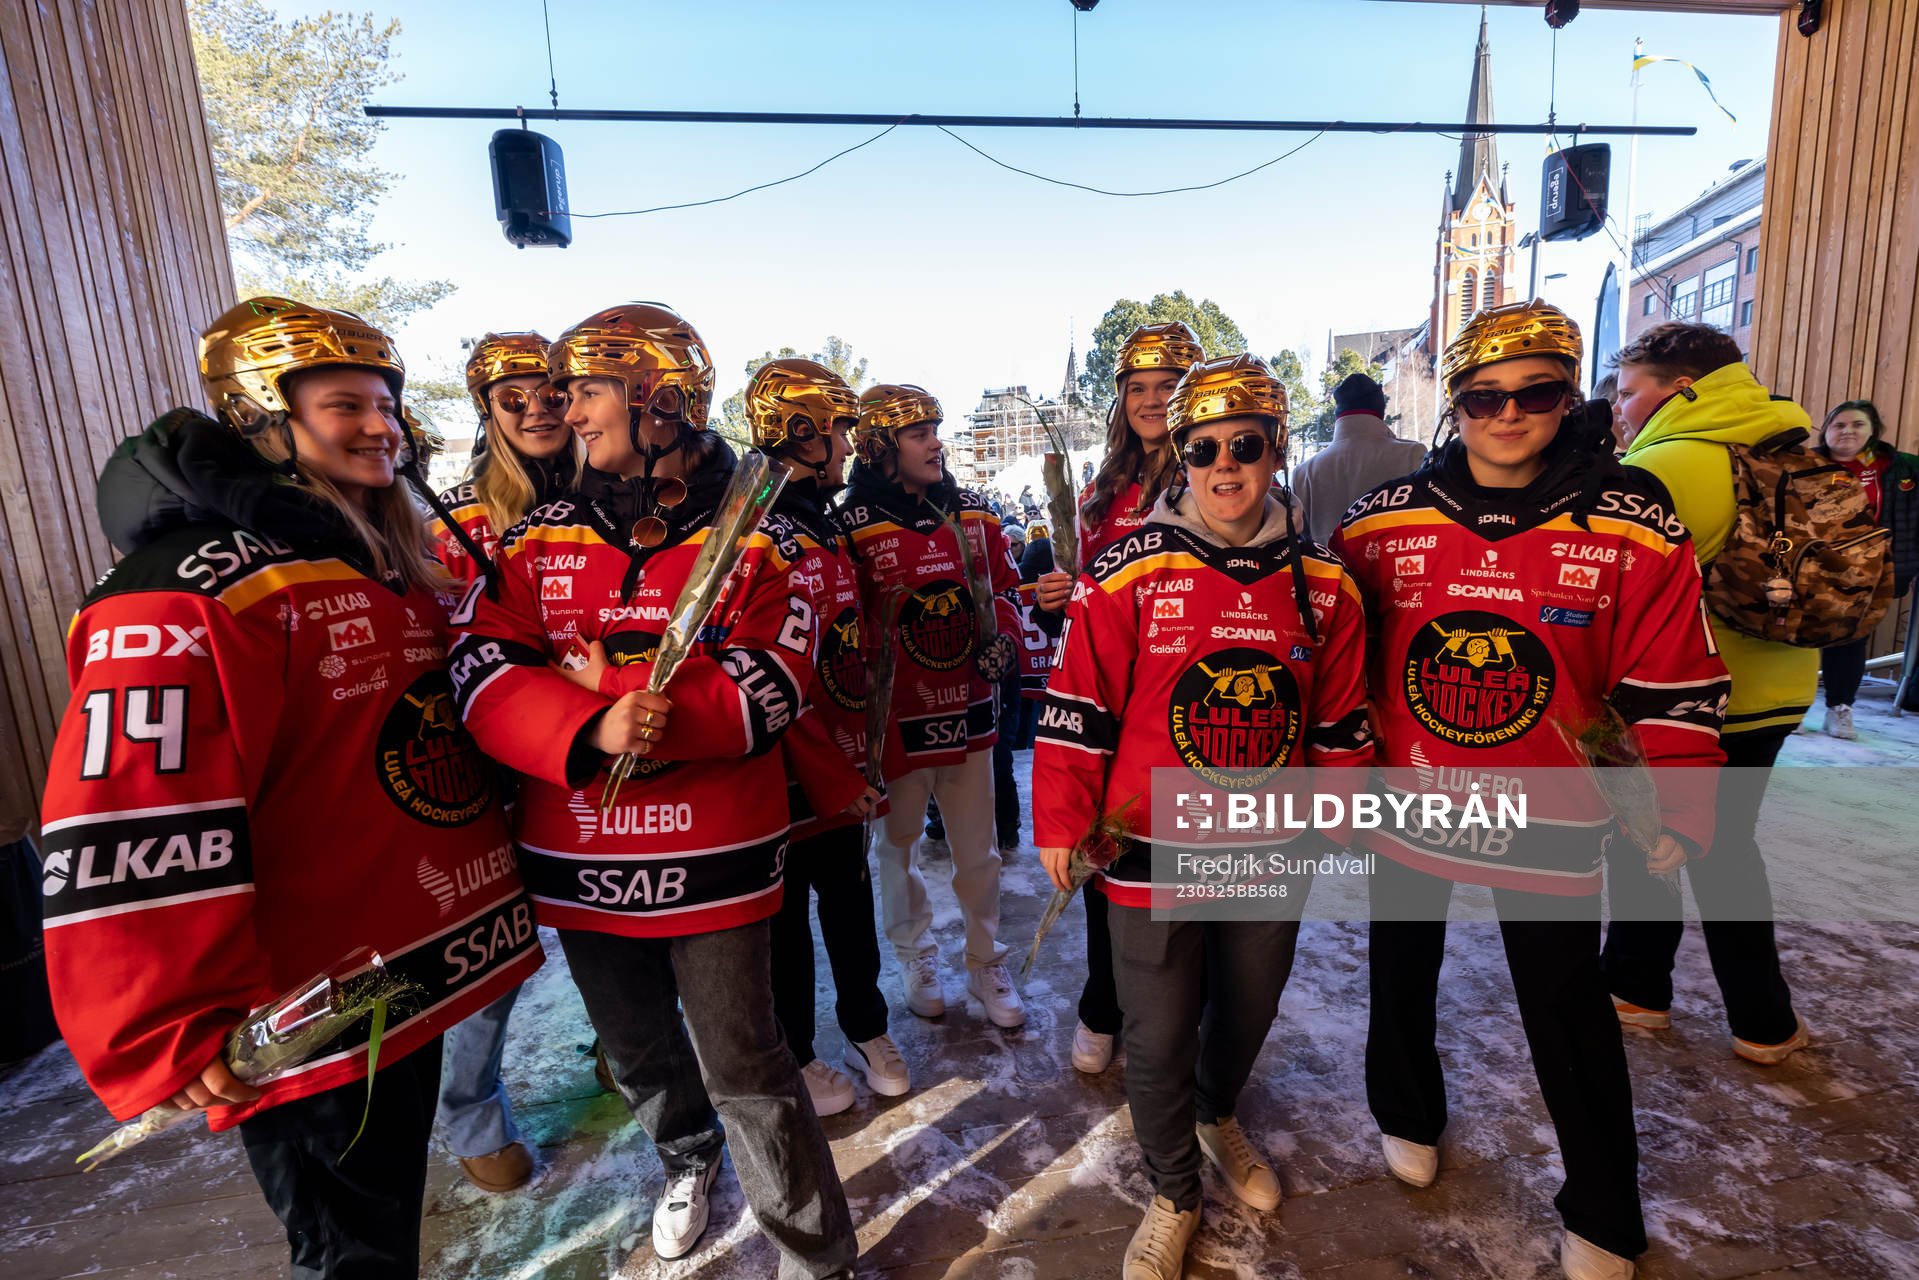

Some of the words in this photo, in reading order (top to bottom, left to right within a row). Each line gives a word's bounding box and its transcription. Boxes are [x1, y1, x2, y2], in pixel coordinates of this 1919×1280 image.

[1550, 173, 1560, 210] egerup
[1343, 484, 1413, 522] SSAB
[1094, 531, 1163, 578] SSAB
[1398, 535, 1438, 551] LKAB
[1568, 543, 1618, 563] LKAB
[546, 554, 587, 570] LKAB
[1460, 568, 1516, 580] LINDBÄCKS
[543, 579, 569, 598] MAX
[1157, 578, 1194, 593] LKAB
[1562, 568, 1595, 588] MAX
[325, 592, 372, 616] LKAB
[1309, 590, 1336, 607] KAB
[1447, 583, 1524, 602] SCANIA
[599, 606, 671, 622] SCANIA
[1155, 600, 1181, 617] MAX
[1221, 610, 1268, 621] LINDBÄCKS
[84, 625, 210, 667] BDX
[333, 622, 372, 648] MAX
[1211, 626, 1277, 642] SCANIA
[1031, 656, 1053, 668] GRA
[1149, 644, 1187, 654] Galären
[1407, 660, 1423, 702] LULEÅ
[1421, 658, 1530, 691] LULEÅ
[332, 679, 390, 701] Galären
[739, 668, 790, 733] LKAB
[1533, 675, 1550, 705] 1977
[1421, 679, 1528, 729] HOCKEY
[80, 685, 190, 780] 14
[924, 718, 968, 745] SSA
[1038, 705, 1083, 734] KAB
[1172, 705, 1192, 750] LULEÅ
[1414, 703, 1537, 744] HOCKEYFÖRENING
[602, 803, 693, 835] LULEBO
[76, 828, 234, 890] LKAB
[577, 867, 688, 905] SSAB
[444, 902, 532, 985] SSAB
